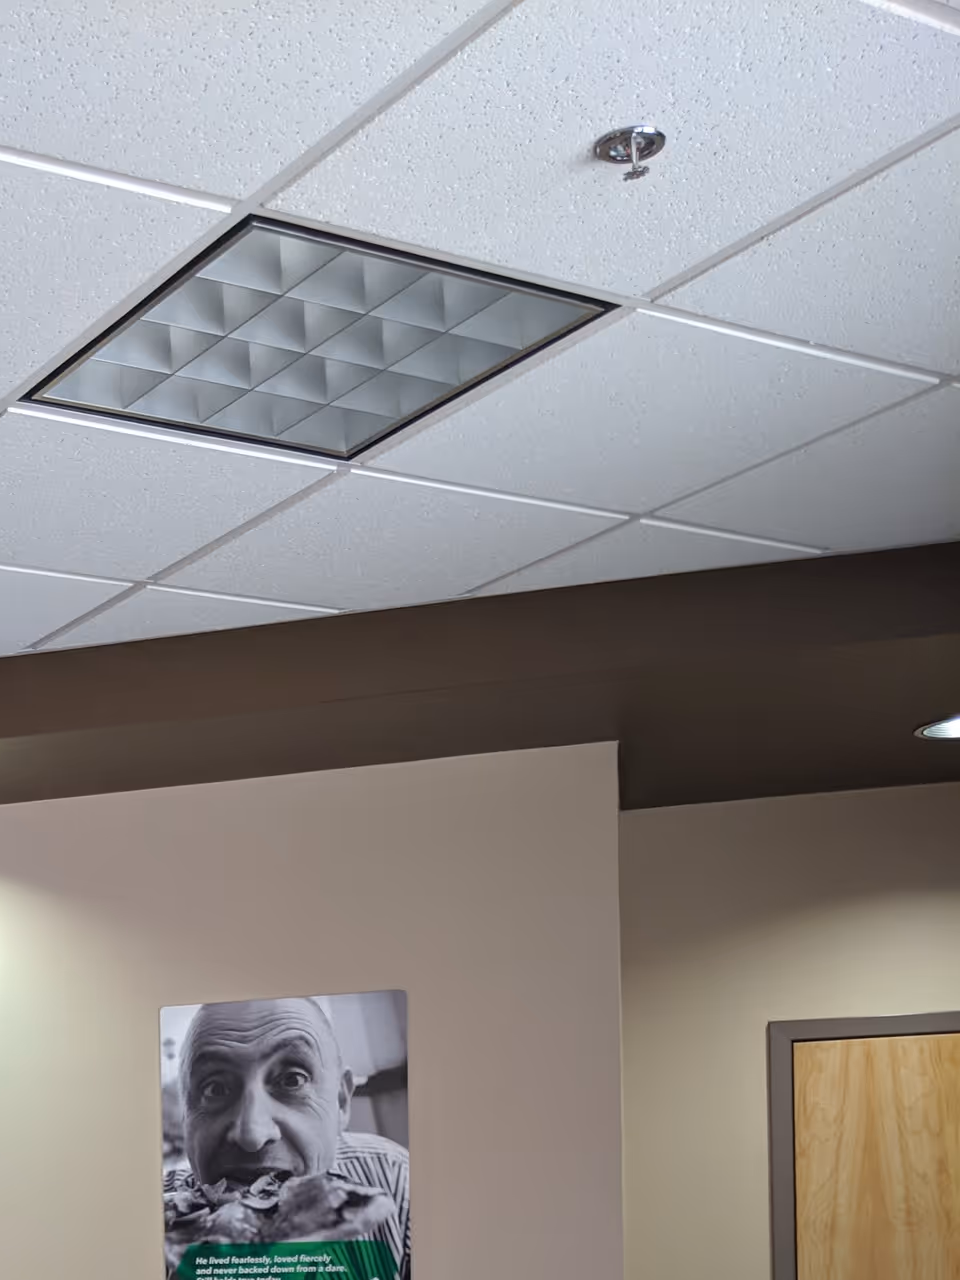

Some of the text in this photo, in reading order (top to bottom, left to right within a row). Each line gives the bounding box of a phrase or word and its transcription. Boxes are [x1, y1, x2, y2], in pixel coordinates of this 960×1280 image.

[209, 1256, 230, 1264] lived
[231, 1255, 272, 1265] fearlessly,
[274, 1255, 298, 1263] loved
[299, 1254, 331, 1264] fiercely
[238, 1266, 269, 1274] backed
[270, 1265, 294, 1273] down
[296, 1265, 317, 1273] from
[325, 1264, 347, 1272] dare.
